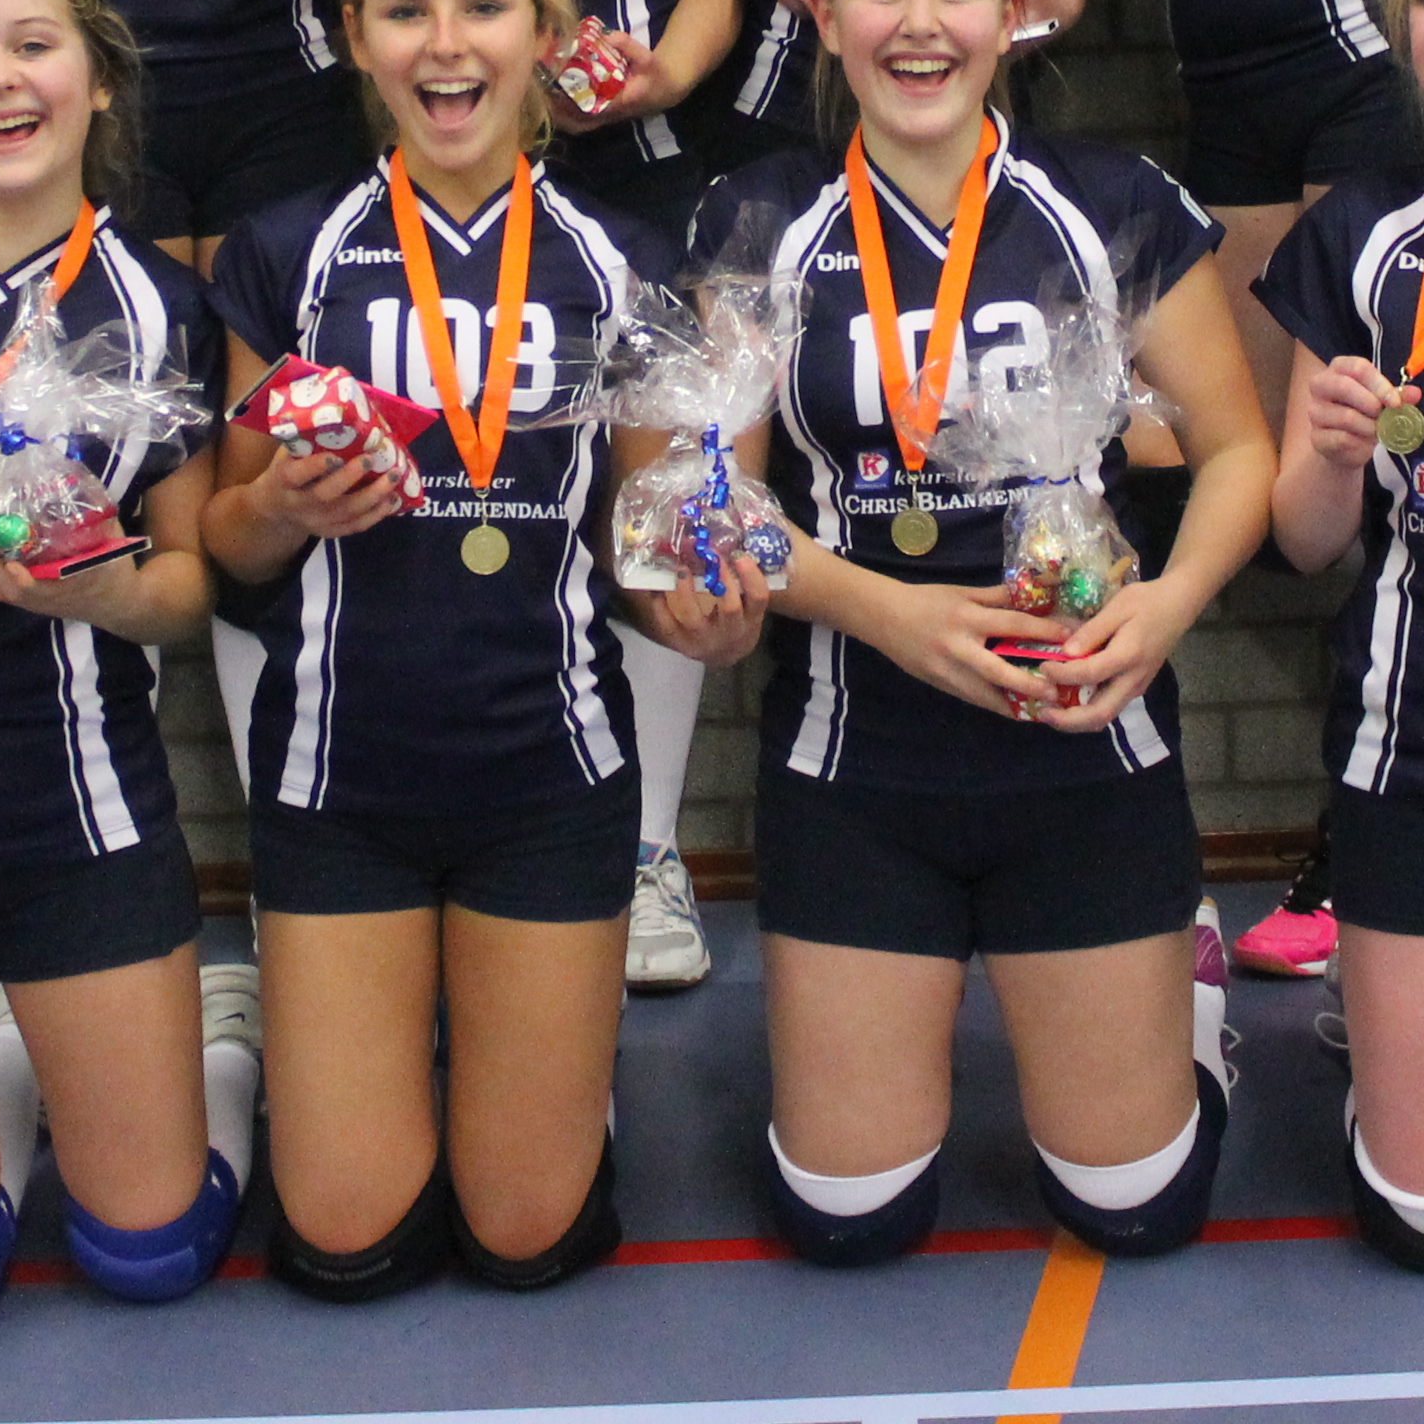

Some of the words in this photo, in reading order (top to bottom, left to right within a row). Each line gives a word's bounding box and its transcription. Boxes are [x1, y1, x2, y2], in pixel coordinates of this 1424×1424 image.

[817, 250, 860, 272] Din
[366, 297, 557, 413] 103
[845, 495, 909, 515] CHRIS
